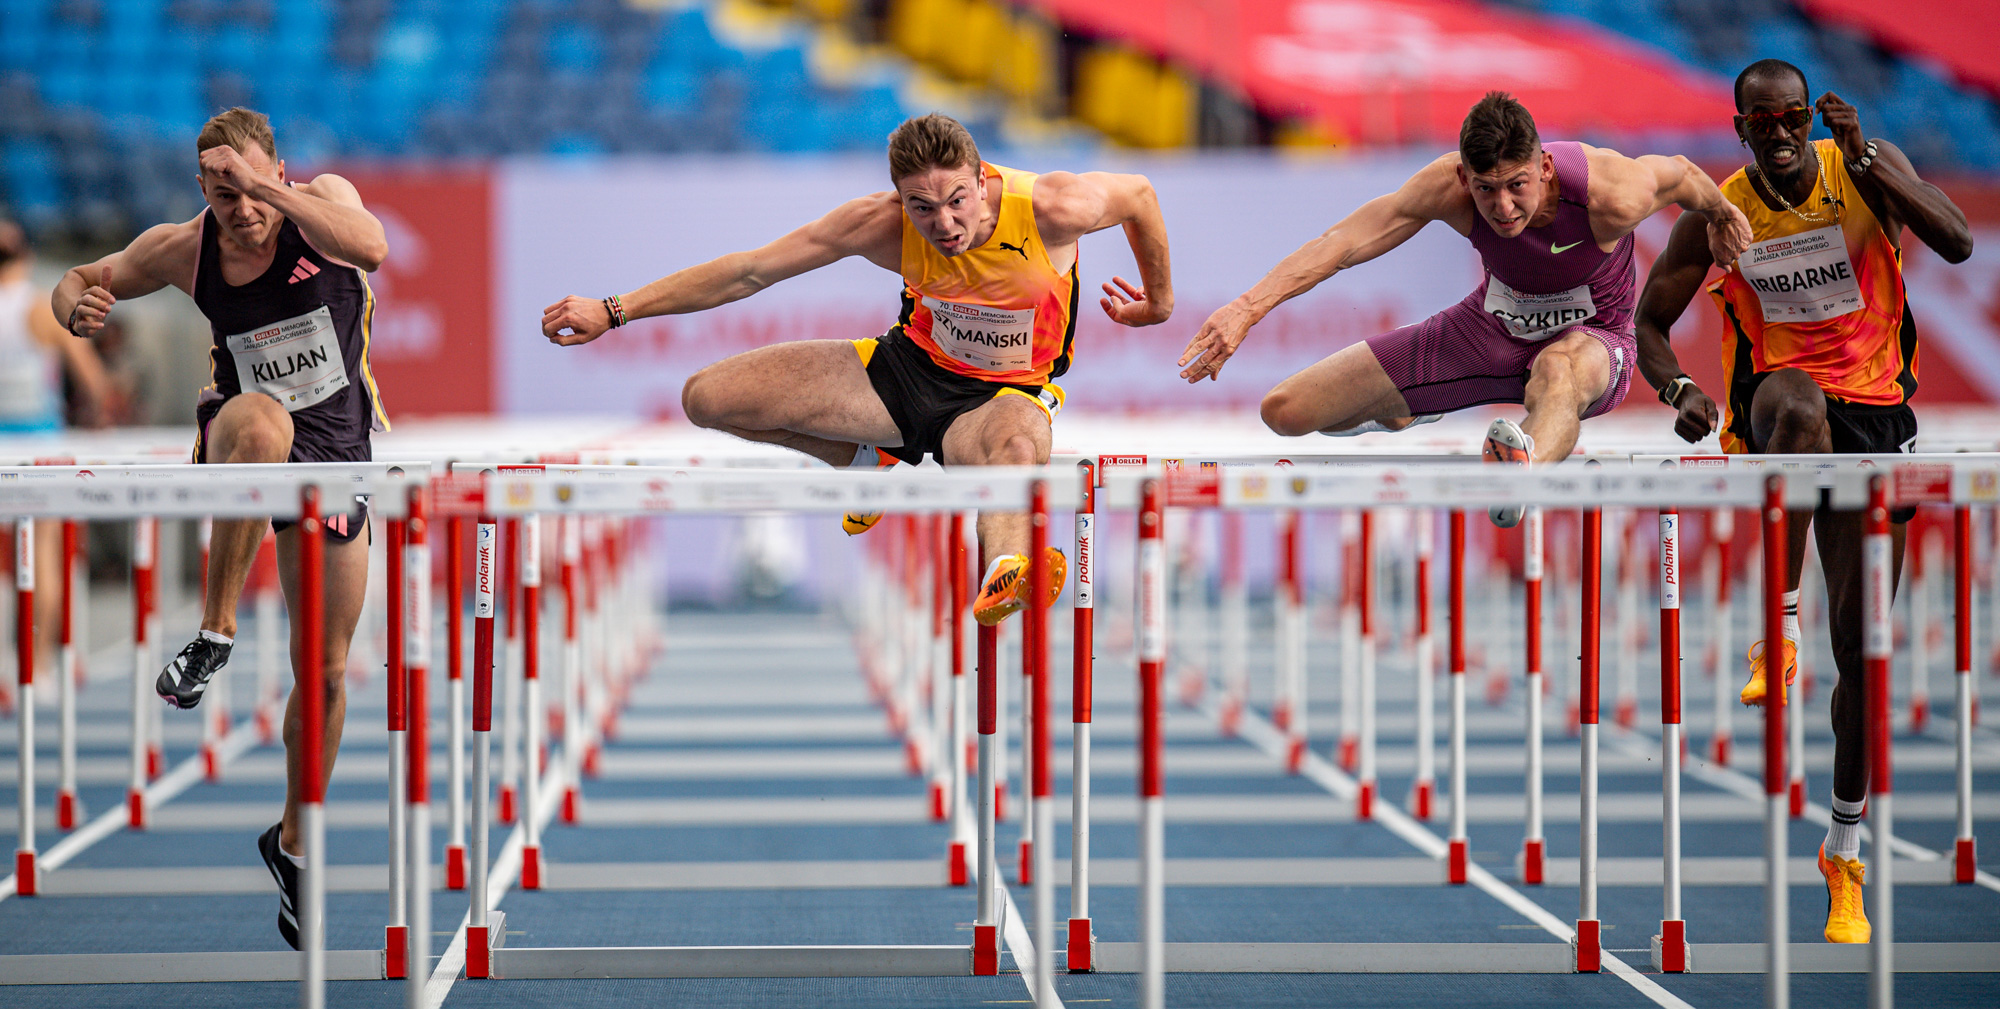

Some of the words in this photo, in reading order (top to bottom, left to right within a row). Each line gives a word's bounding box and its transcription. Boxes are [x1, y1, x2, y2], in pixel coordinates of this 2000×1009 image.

[1752, 248, 1766, 256] 70.
[1767, 243, 1791, 252] ORLEN
[1792, 235, 1826, 247] MEMORIAŁ
[1753, 253, 1780, 263] JANUSZA
[1780, 241, 1830, 257] KUSOCIŃSKIEGO
[1750, 261, 1851, 293] IRIBARNE
[940, 301, 952, 311] 70.
[953, 306, 979, 316] ORLEN
[980, 311, 1015, 319] MEMORIAŁ
[965, 315, 1017, 324] KUSOCIŃSKIEGO
[241, 336, 255, 344] 70.
[255, 329, 280, 340] ORLEN
[281, 319, 314, 333] MEMORIAŁ
[244, 341, 269, 350] JANUSZA
[269, 325, 318, 345] KUSOCIŃSKIEGO
[251, 344, 328, 383] KILJAN
[1103, 457, 1116, 466] 70.
[478, 546, 491, 594] polanik
[1078, 536, 1091, 584] polanik
[1663, 536, 1676, 585] polanik
[983, 565, 1021, 600] NITRO
